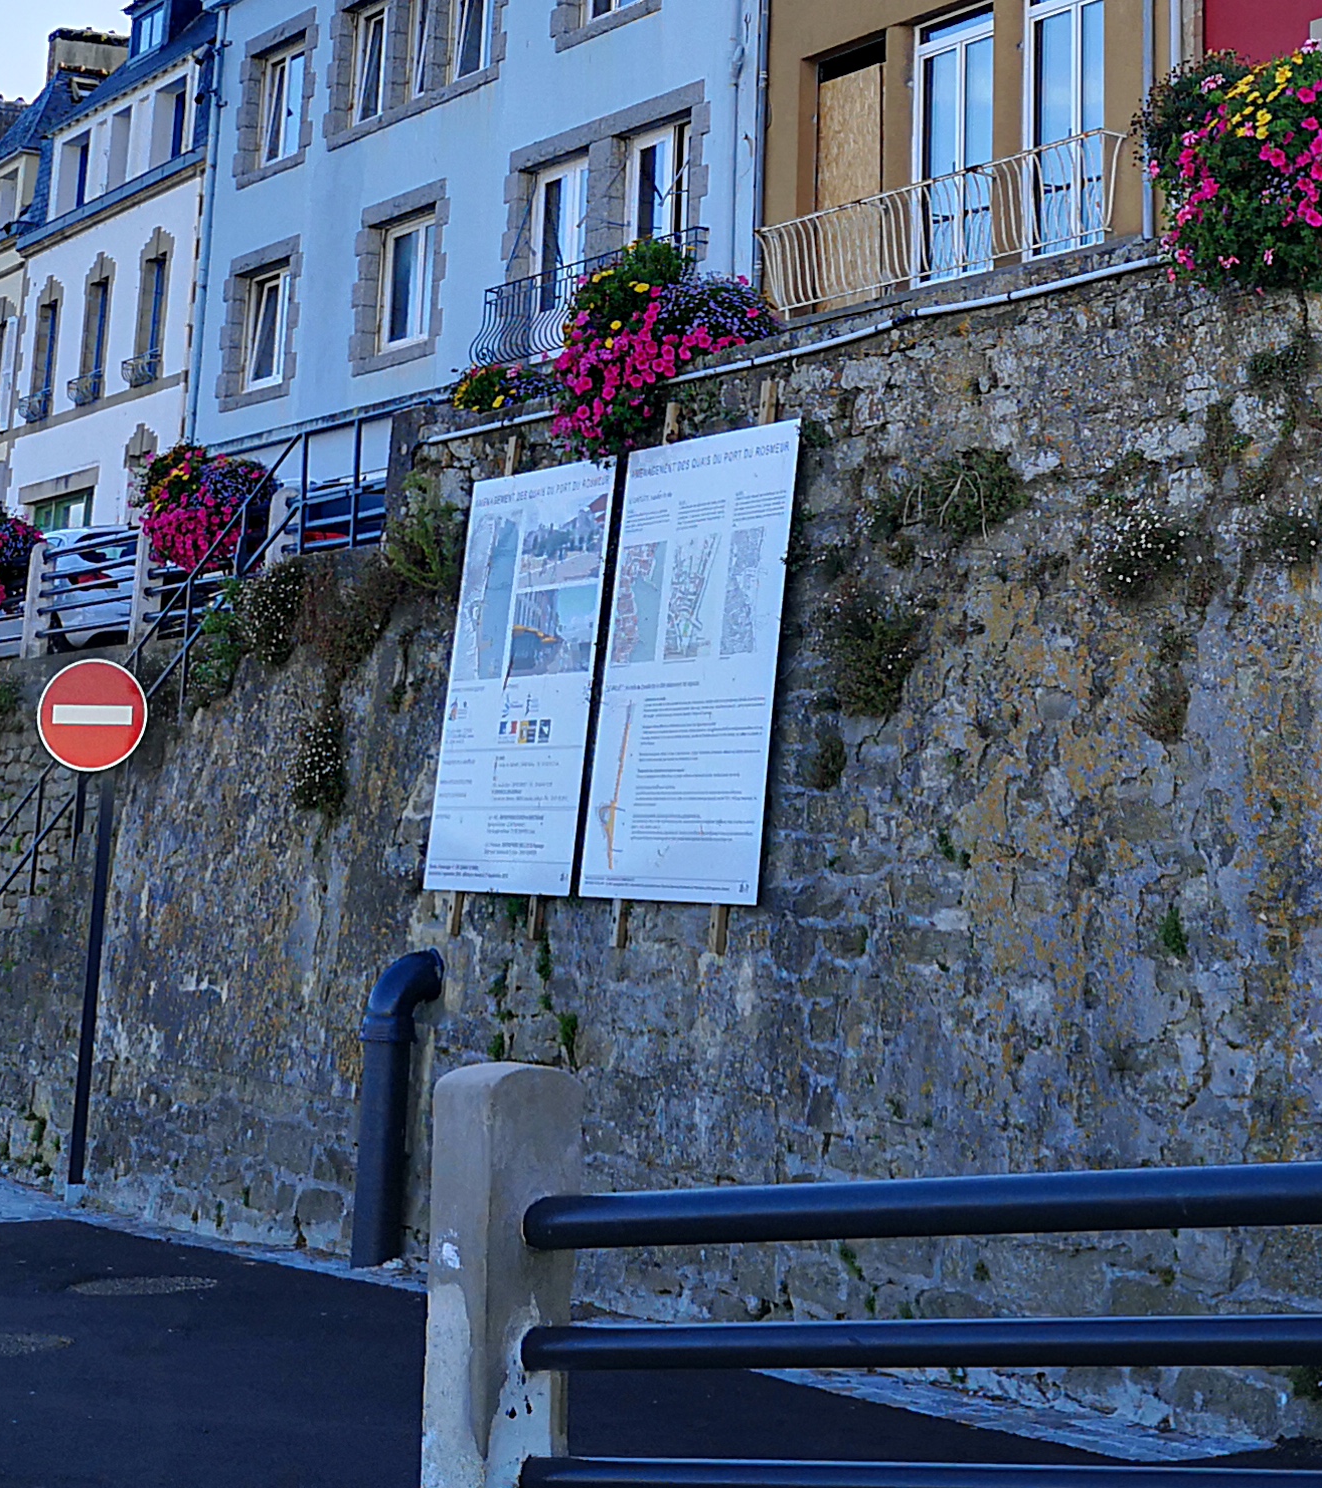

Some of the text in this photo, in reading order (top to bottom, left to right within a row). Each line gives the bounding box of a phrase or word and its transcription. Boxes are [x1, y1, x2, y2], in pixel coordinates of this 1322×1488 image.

[677, 459, 690, 472] DES
[691, 455, 711, 469] QUAIS
[712, 453, 722, 464] DU
[723, 450, 743, 463] PORT
[744, 448, 754, 459] DU
[755, 441, 790, 456] ROSMEUR
[556, 482, 571, 494] PORT
